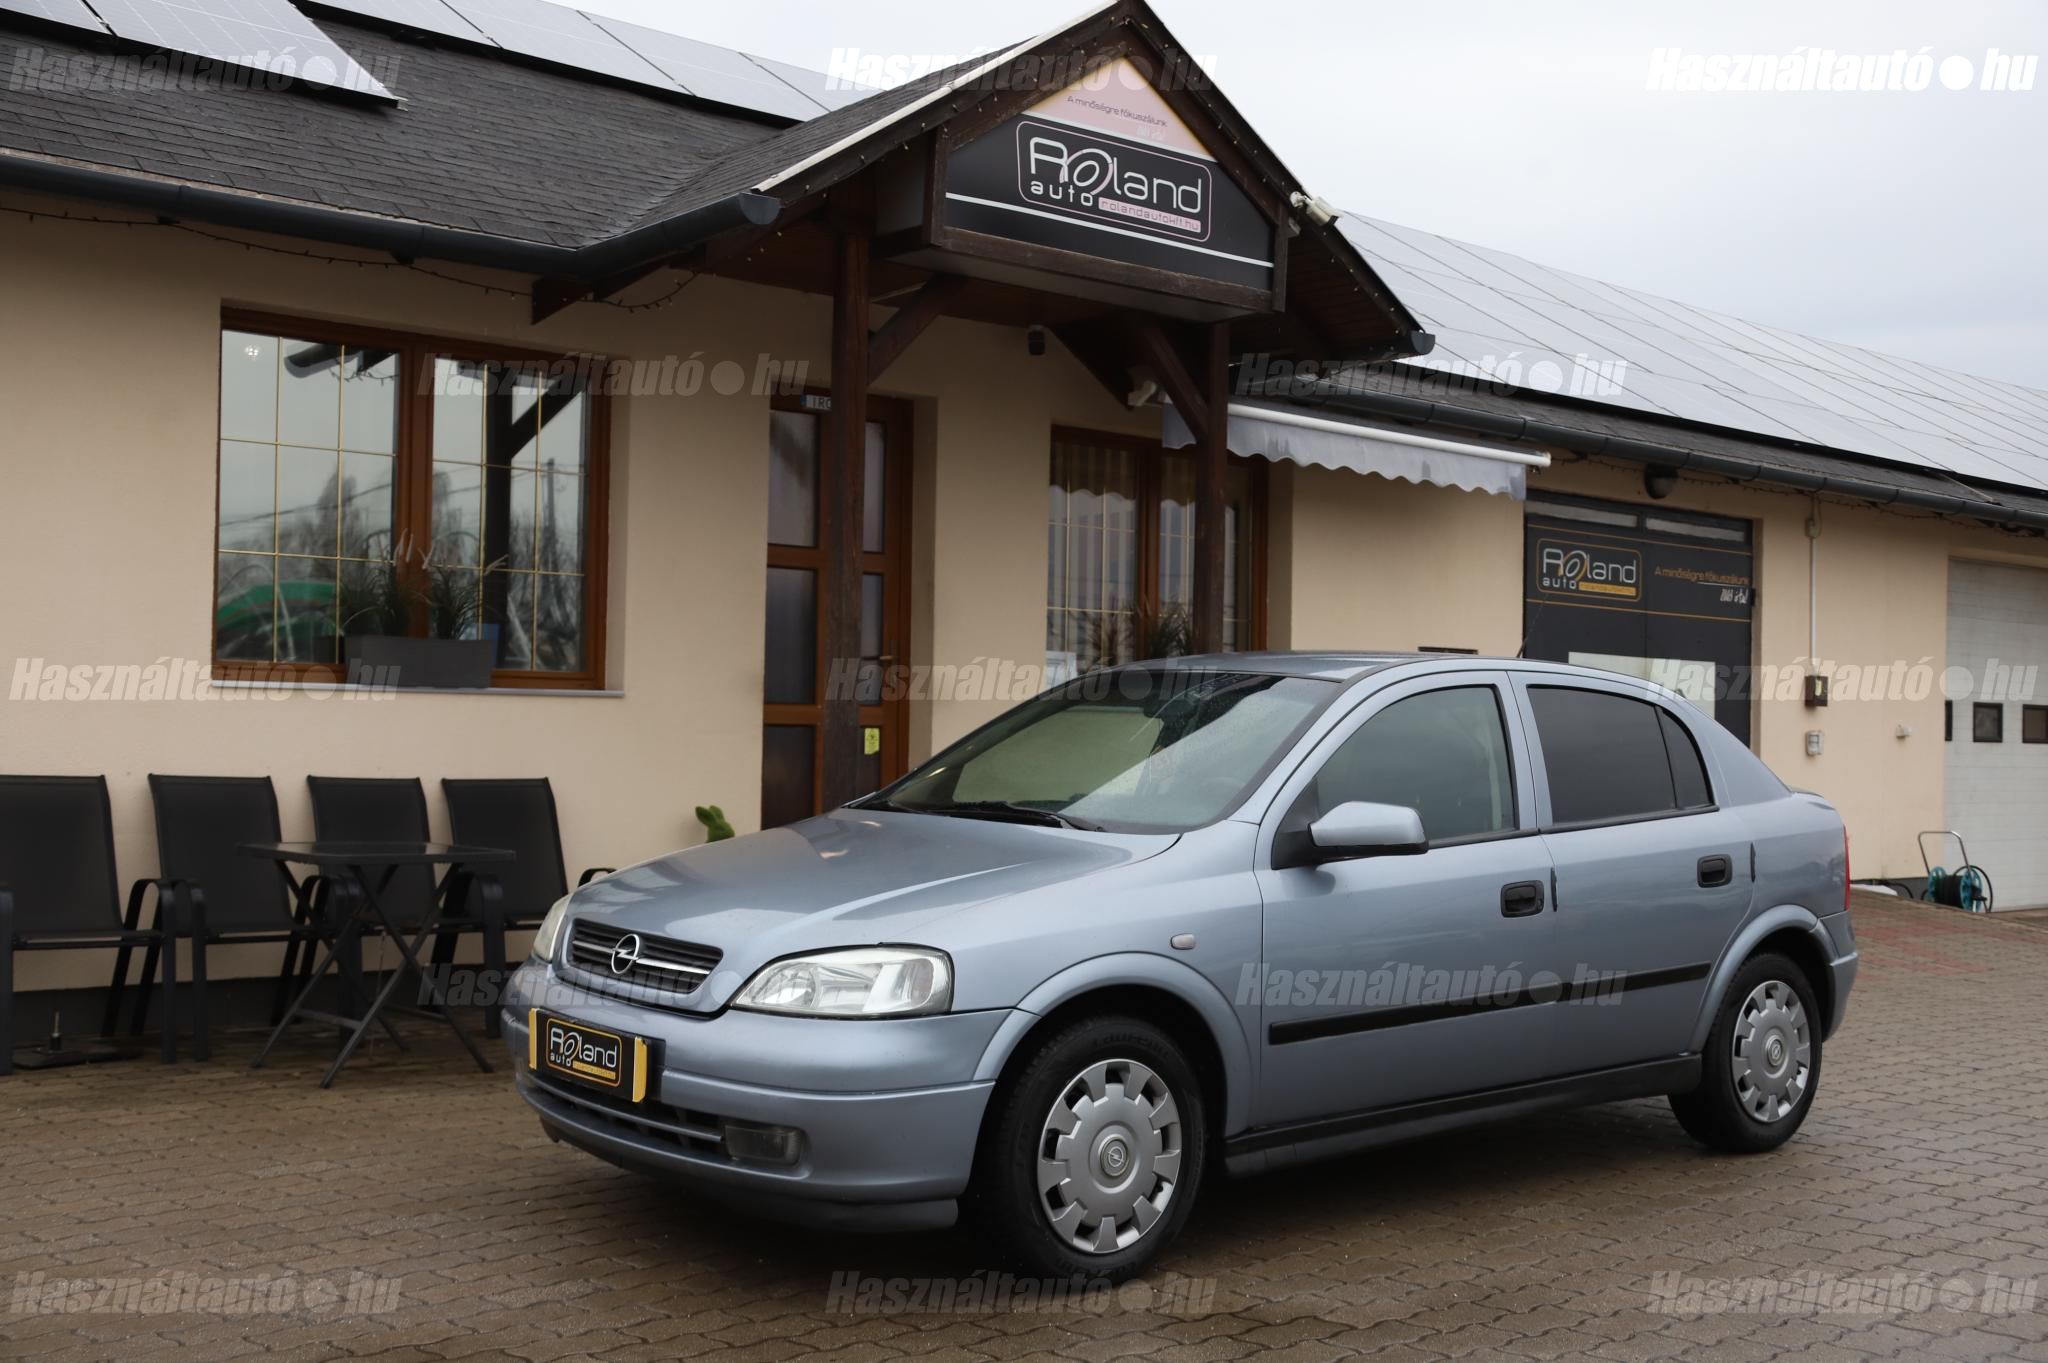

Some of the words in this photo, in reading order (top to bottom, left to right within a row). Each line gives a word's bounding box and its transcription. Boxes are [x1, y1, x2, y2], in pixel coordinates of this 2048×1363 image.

[1029, 136, 1202, 214] Roland
[1030, 179, 1094, 208] auto
[1542, 547, 1637, 584] Roland
[1542, 576, 1577, 590] auto
[550, 1027, 617, 1068] Roland
[550, 1052, 572, 1067] auto
